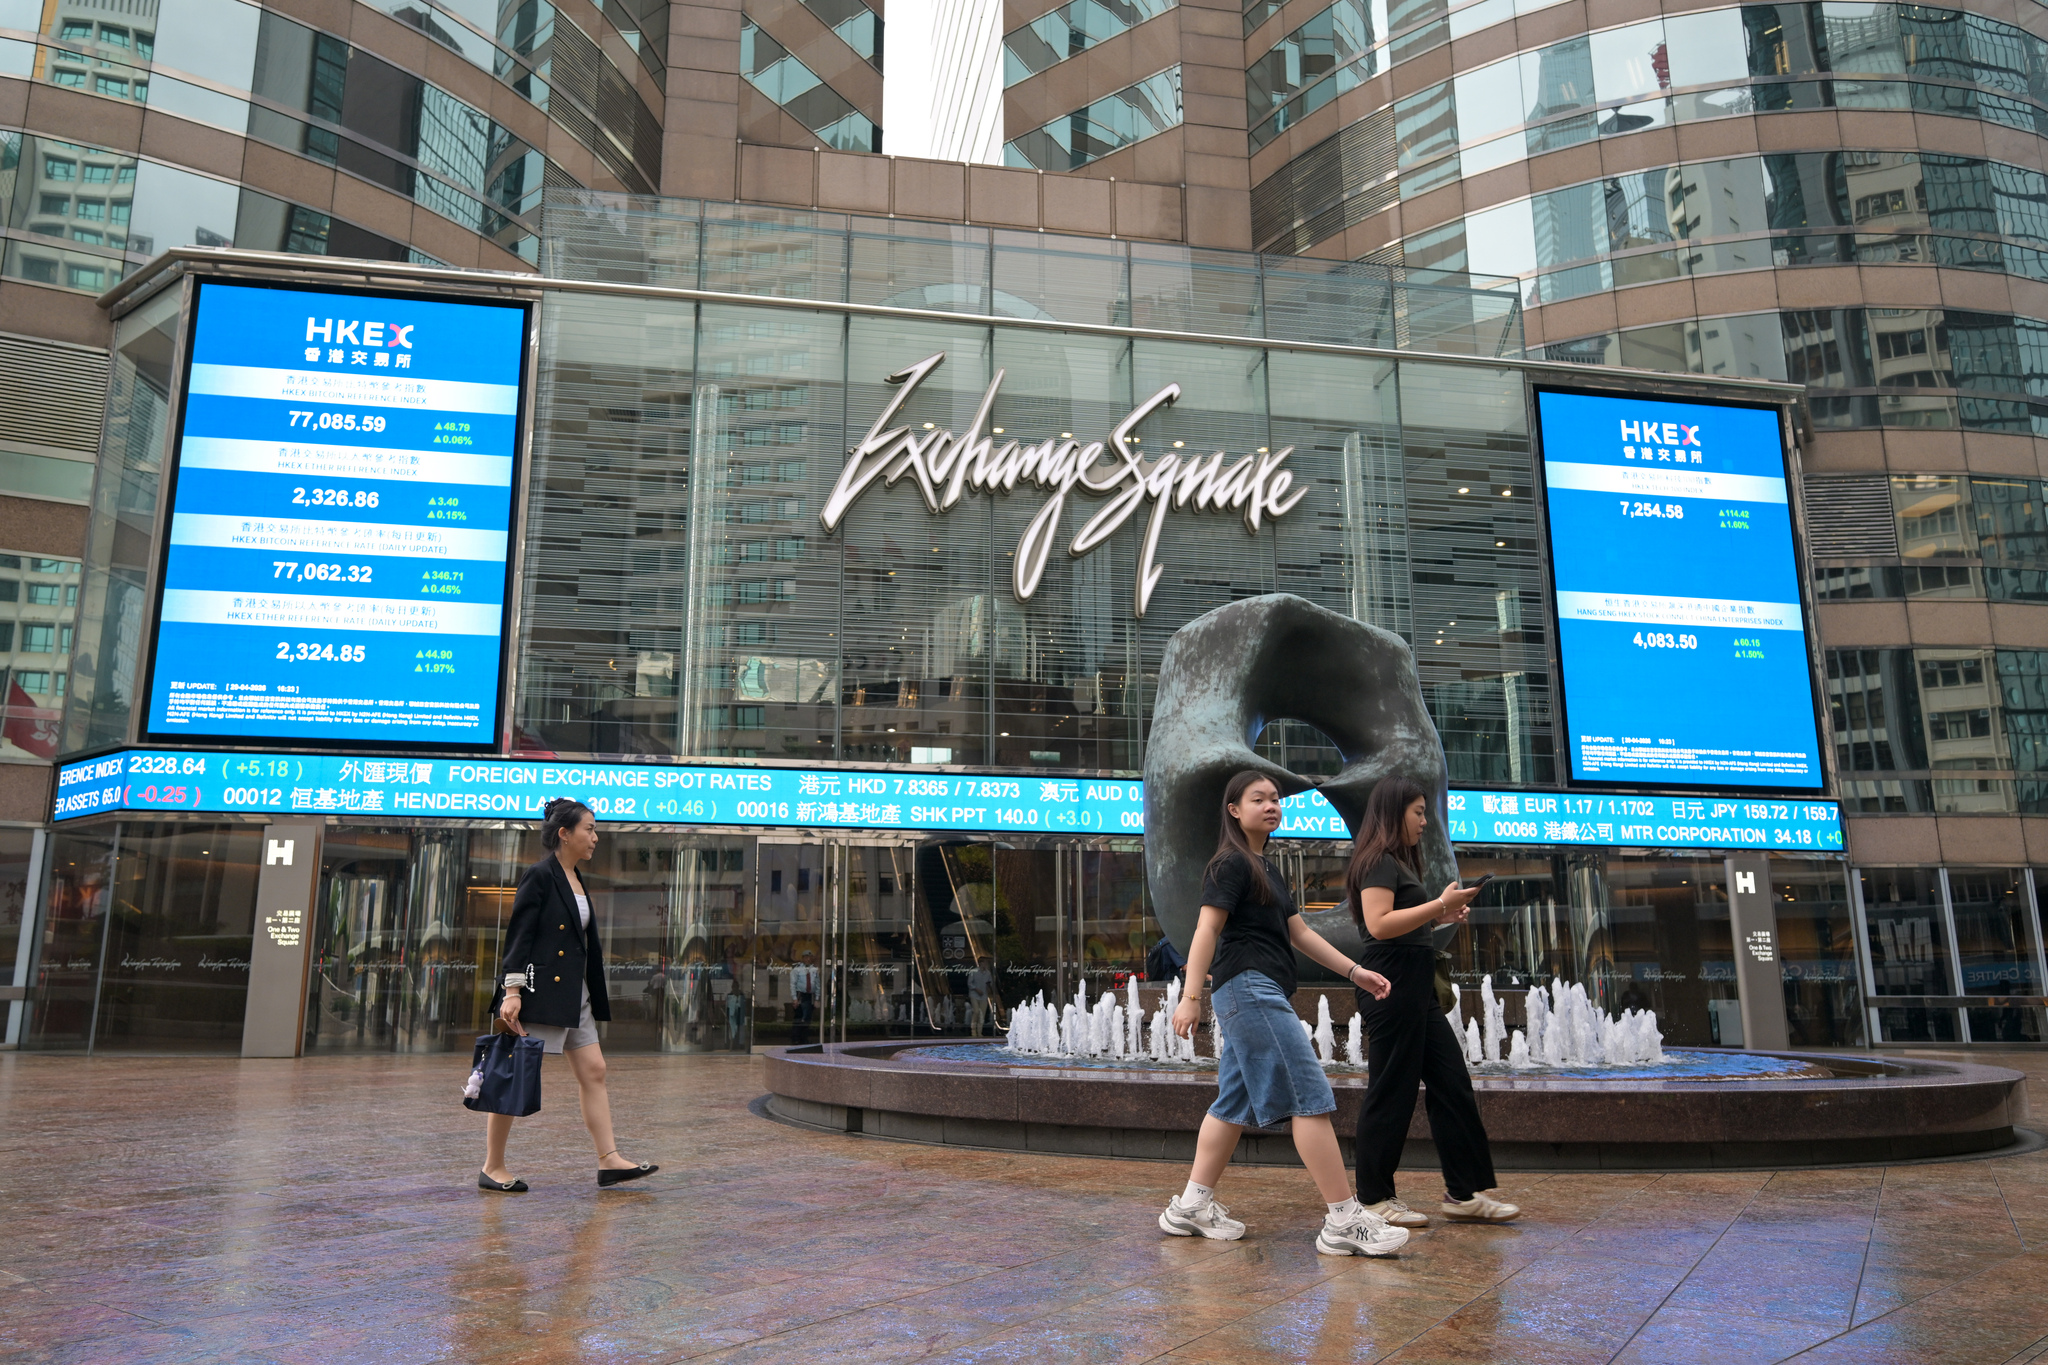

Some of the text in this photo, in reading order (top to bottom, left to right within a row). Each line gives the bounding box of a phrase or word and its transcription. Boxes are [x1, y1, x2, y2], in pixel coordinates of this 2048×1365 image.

[305, 316, 414, 349] HKEX
[304, 347, 411, 369] 香港交易所
[281, 387, 428, 406] HKEX BITCOIN REFERENCE INDEX
[288, 410, 387, 433] 77,085.59
[443, 421, 471, 432] 48.79
[442, 434, 473, 446] 0.06%
[1620, 419, 1701, 447] HKEX
[1623, 446, 1703, 464] 香港交易所
[277, 460, 418, 477] HKEX ETHER REFERENCE INDEX
[819, 350, 1310, 619] Exchange Square
[292, 486, 380, 510] 2,326.86
[438, 496, 459, 507] 3.40
[436, 509, 467, 521] 0.15%
[1619, 501, 1684, 519] 7,254.58
[1726, 509, 1750, 519] 114.42
[1726, 520, 1750, 530] 1.60%
[231, 534, 448, 555] HKEX BITCOIN REFERENCE RATE (DAILY UPDATE)
[272, 561, 373, 584] 77,062.32
[432, 569, 464, 581] 346.71
[430, 583, 462, 595] 0.45%
[226, 610, 439, 630] HKEX ETHER REFERENCE RATE (DAILY UPDATE)
[1576, 607, 1598, 617] HANG
[1598, 608, 1617, 618] SENG
[1618, 610, 1637, 619] HKEX
[1718, 615, 1763, 626] ENTERPRISES
[1763, 618, 1784, 627] INDEX
[1633, 631, 1698, 650] 4,083.50
[1740, 638, 1761, 648] 60.15
[275, 641, 366, 664] 2,324.85
[424, 649, 453, 660] 44.90
[1741, 650, 1765, 660] 1.50%
[424, 663, 456, 675] 1.97%
[95, 757, 124, 779] INDEX
[128, 755, 206, 774] 2328.64
[338, 759, 434, 784] 外匯現價
[448, 765, 538, 784] FOREIGN
[542, 767, 650, 788] EXCHANGE
[654, 771, 706, 789] SPOT
[710, 773, 772, 791] RATES
[798, 774, 841, 796] 港元
[848, 776, 887, 794] HKD
[893, 778, 948, 796] 7.8365
[966, 781, 1021, 798] 7.8373
[1039, 780, 1080, 802] 澳元
[1085, 785, 1123, 801] AUD
[65, 790, 100, 812] ASSETS
[101, 785, 122, 806] 65.0
[223, 787, 282, 806] 00012
[289, 787, 384, 811] 恒基地產
[394, 791, 520, 812] HENDERSON
[587, 796, 637, 815] 30.82
[736, 801, 789, 819] 00016
[796, 801, 902, 824] 新鴻基地產
[910, 806, 948, 823] SHK
[951, 807, 987, 823] PPT
[994, 808, 1038, 826] 140.0
[1481, 794, 1520, 815] 歐羅
[1524, 797, 1558, 814] EUR
[1563, 798, 1592, 815] 1.17
[1608, 800, 1655, 816] 1.1702
[1671, 801, 1706, 821] 日元
[1710, 803, 1738, 819] JPY
[1743, 804, 1788, 820] 159.72
[1803, 806, 1839, 821] 159.7
[1494, 821, 1538, 838] 00066
[1543, 820, 1614, 842] 港鐵公司
[1620, 824, 1654, 840] MTR
[1657, 825, 1767, 844] CORPORATION
[1774, 829, 1812, 845] 34.18
[266, 839, 295, 866] H
[1735, 871, 1756, 894] H
[270, 932, 300, 940] Exchange
